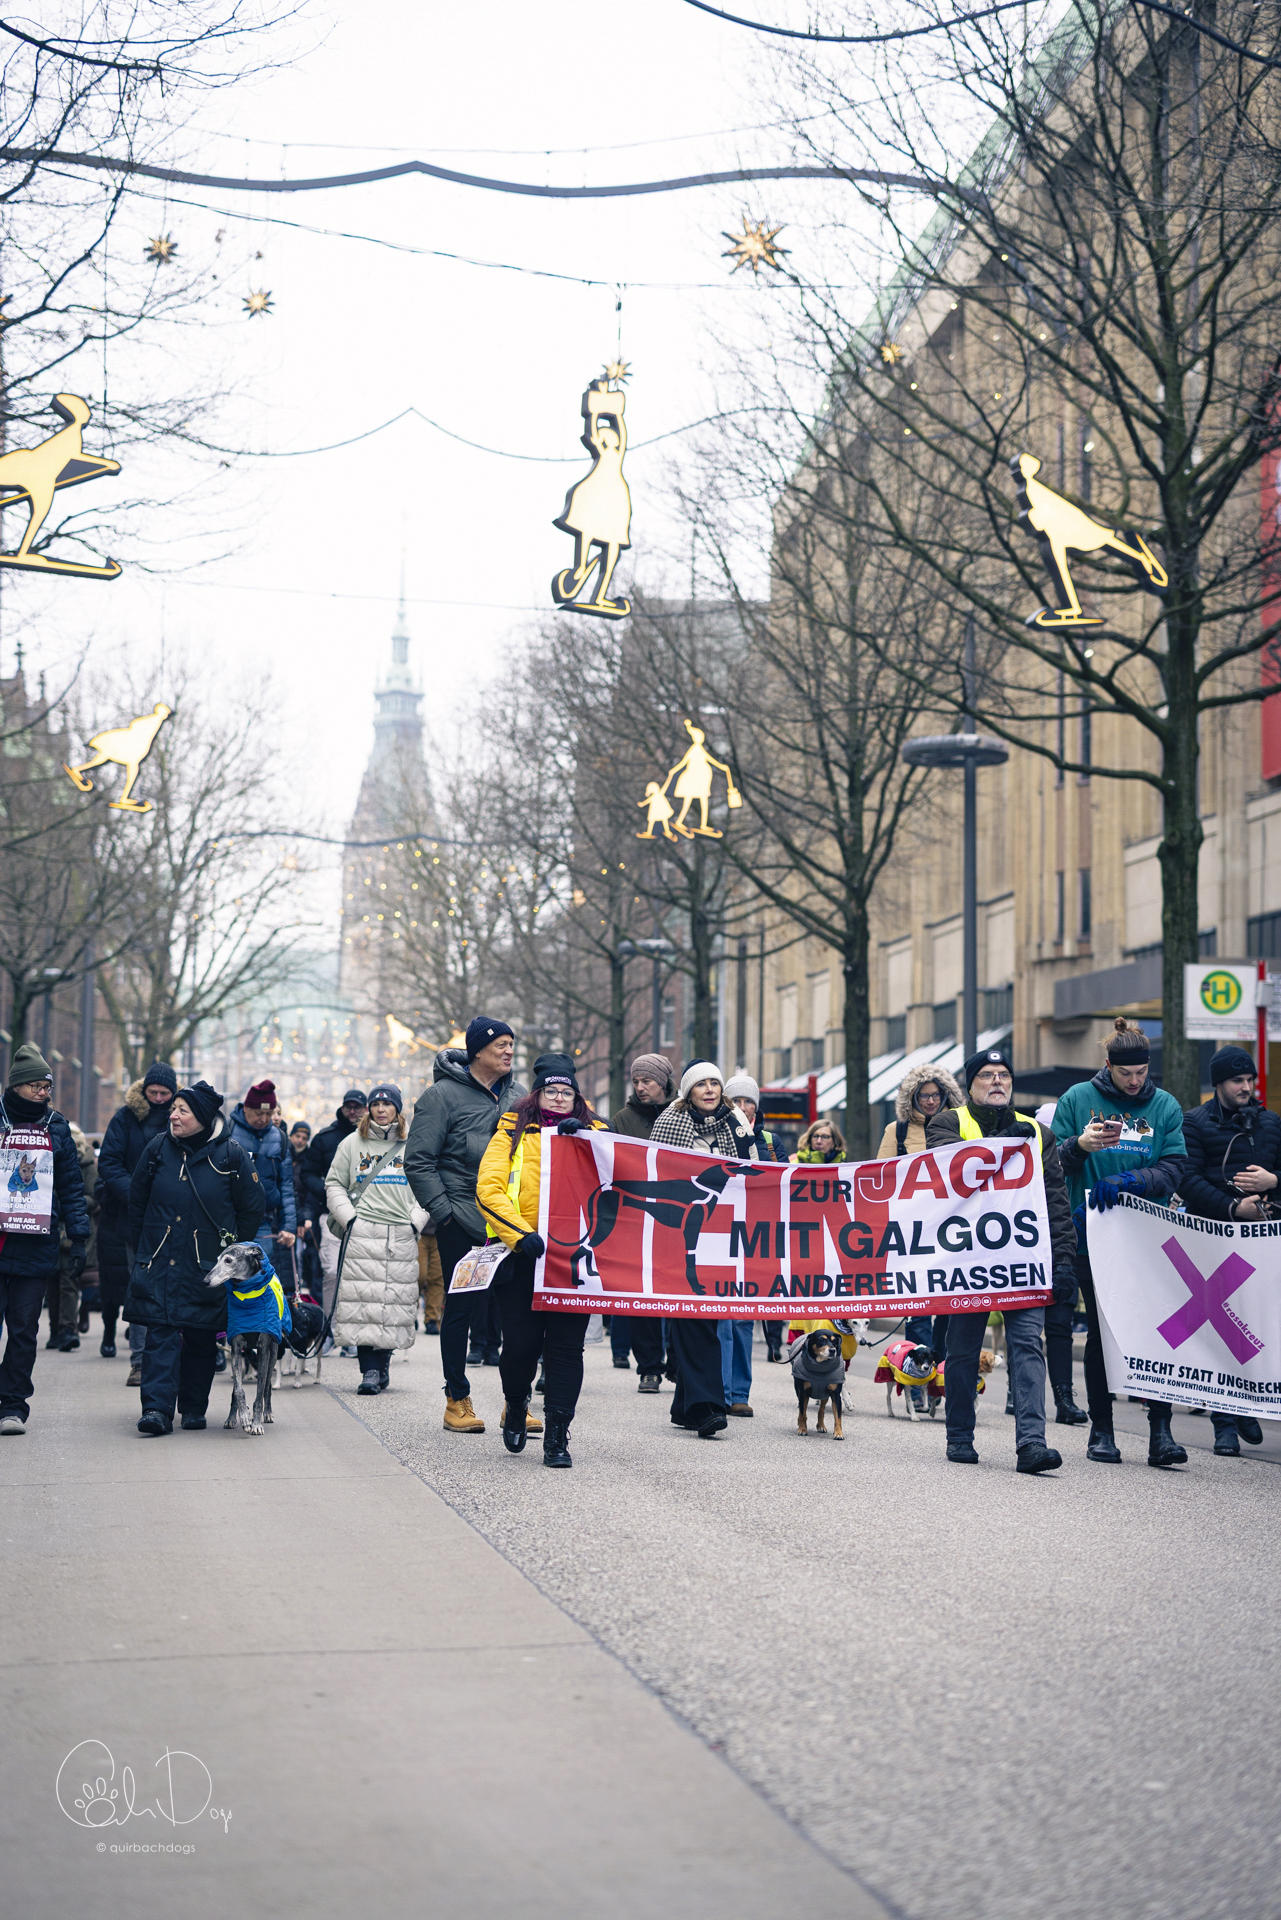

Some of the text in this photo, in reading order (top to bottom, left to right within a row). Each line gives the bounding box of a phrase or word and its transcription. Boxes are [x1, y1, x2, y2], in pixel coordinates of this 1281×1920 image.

[1212, 981, 1231, 1004] H
[4, 1134, 50, 1147] STERBEN
[790, 1142, 1034, 1204] ZUR JAGD
[1117, 1193, 1234, 1238] MASSENTIERHALTUNG
[729, 1209, 1039, 1260] MIT GALGOS
[715, 1262, 1046, 1298] UND ANDEREN RASSEN
[562, 1298, 612, 1308] wehrloser
[614, 1300, 630, 1309] ein
[632, 1300, 680, 1313] Geschöpf
[682, 1303, 697, 1313] ist,
[700, 1304, 727, 1313] desto
[730, 1304, 755, 1313] mehr
[758, 1304, 787, 1314] Recht
[789, 1305, 805, 1314] hat
[807, 1306, 823, 1315] es,
[825, 1303, 873, 1314] verteidigt
[1222, 1301, 1266, 1350] #rosakreuz
[1167, 1378, 1226, 1396] KONVENTIONELLER
[1178, 1365, 1214, 1383] STATT
[1217, 1372, 1281, 1394] UNGERECH
